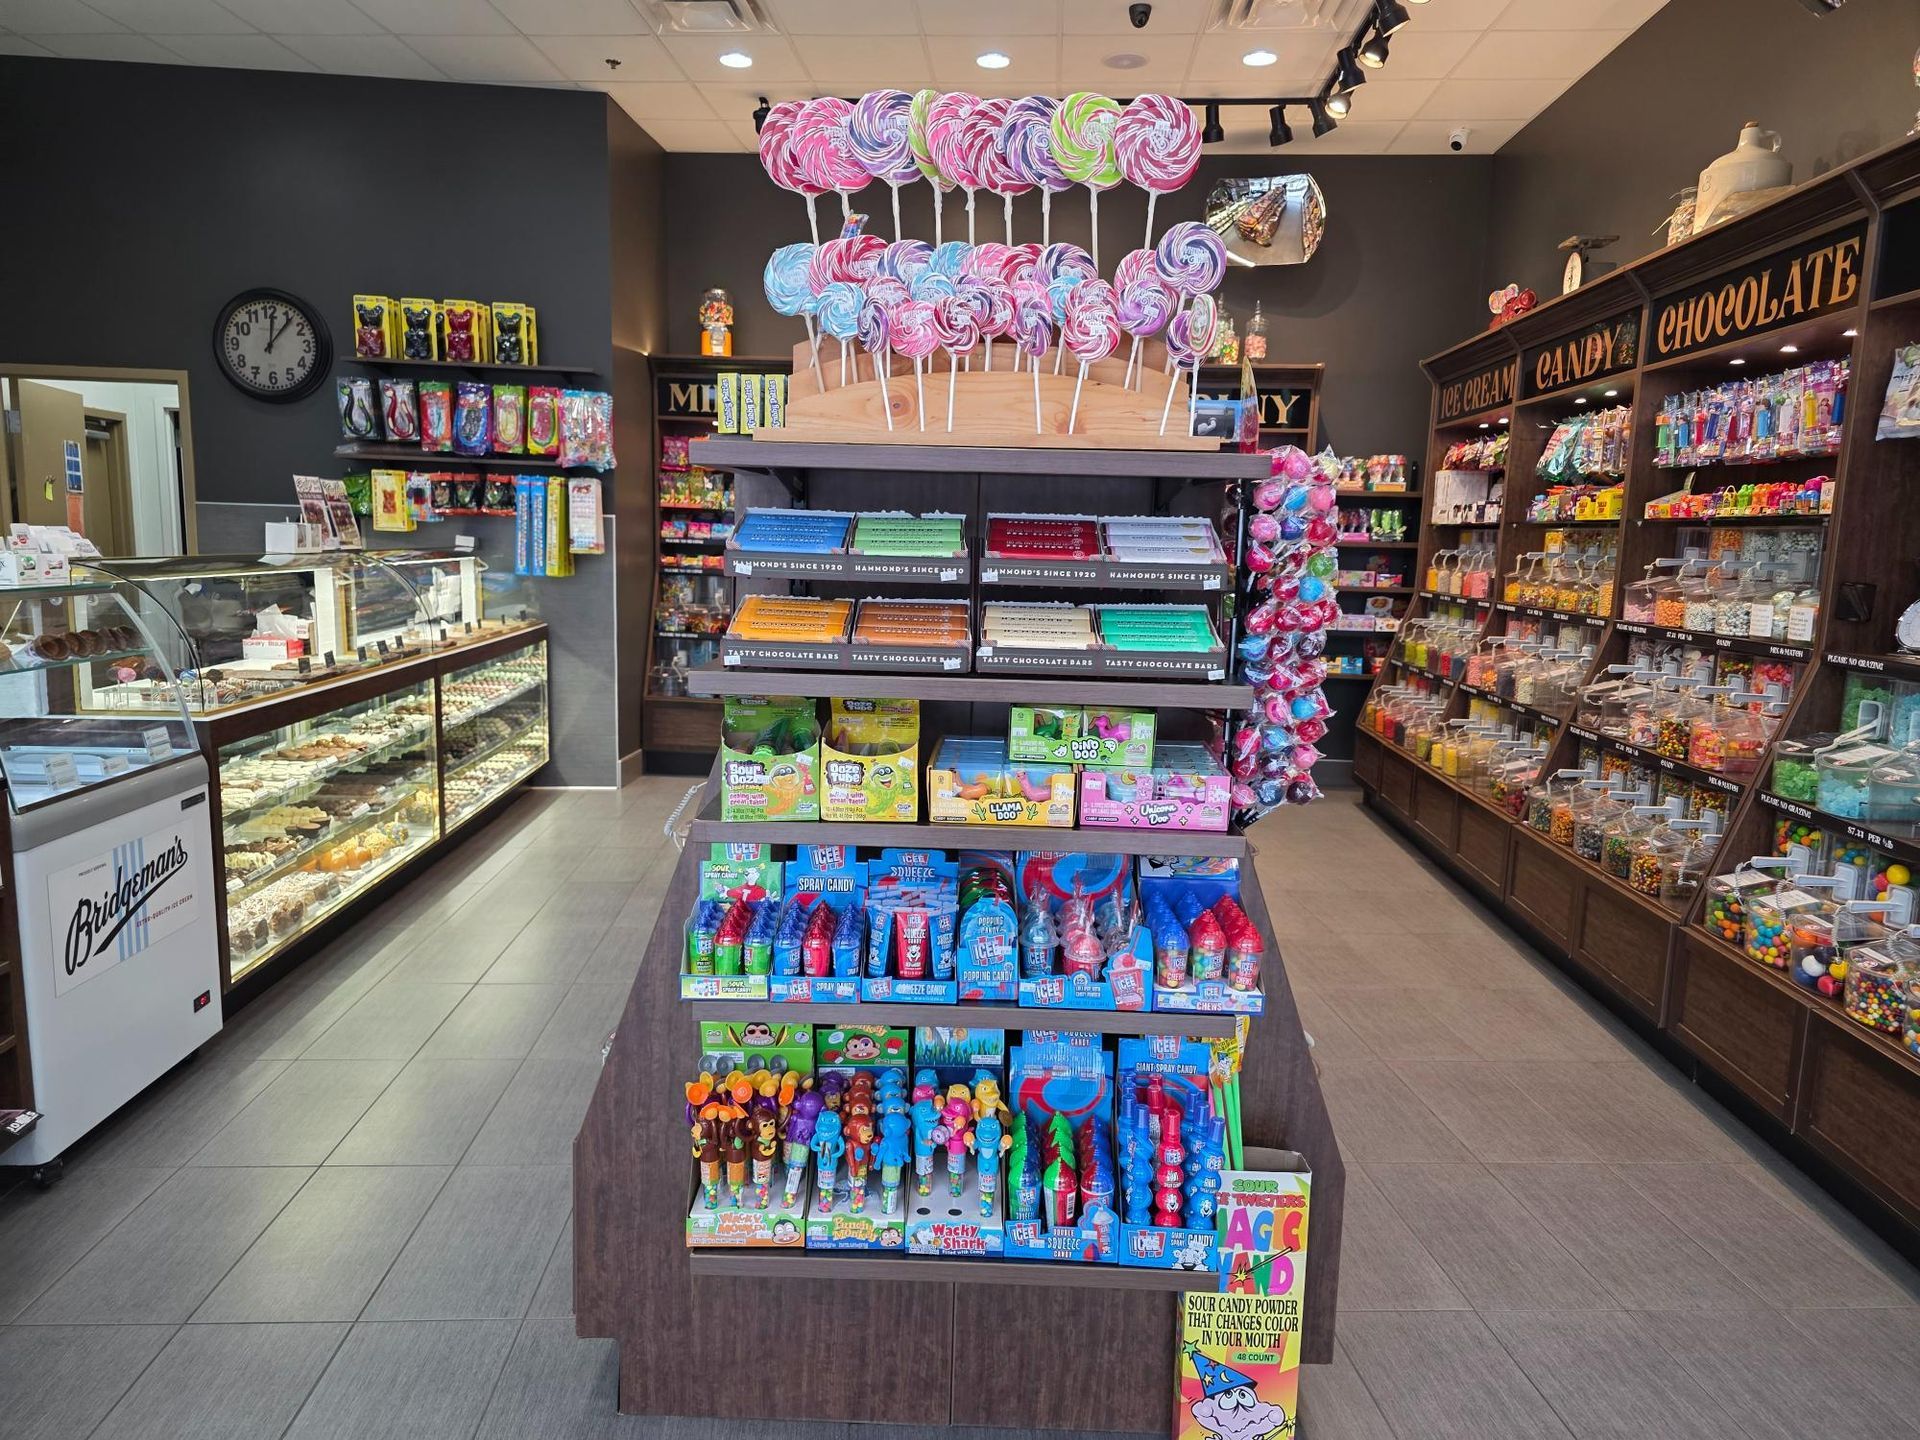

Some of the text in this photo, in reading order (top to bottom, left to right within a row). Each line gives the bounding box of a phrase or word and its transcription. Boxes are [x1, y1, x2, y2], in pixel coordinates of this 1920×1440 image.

[1657, 236, 1861, 354] CHOCOLATE
[246, 309, 258, 323] 11
[261, 305, 278, 320] 12
[233, 321, 250, 336] 10
[296, 322, 306, 336] 2
[230, 337, 240, 350] 9
[302, 340, 312, 354] 3
[238, 354, 246, 368] 8
[298, 356, 306, 370] 4
[1535, 324, 1622, 390] CANDY
[251, 366, 260, 380] 7
[268, 372, 278, 385] 6
[286, 368, 295, 381] 5
[1441, 363, 1516, 419] ICE CREAM
[668, 383, 717, 413] MI
[790, 562, 818, 570] SINCE
[855, 564, 909, 573] HAMMOND'S
[1110, 571, 1165, 580] HAMMOND'S
[1199, 573, 1222, 581] 1920
[728, 649, 756, 658] TASTY
[758, 650, 814, 660] CHOCOLATE
[852, 654, 880, 662] TASTY
[882, 655, 938, 663] CHOCOLATE
[982, 656, 1010, 664] TASTY
[1012, 657, 1068, 666] CHOCOLATE
[1106, 660, 1218, 670] TASTY CHOCOLATE BARS
[1828, 654, 1884, 670] PLEASE NO GRAZING
[1074, 750, 1097, 760] DOO
[730, 764, 761, 775] Sour
[830, 762, 860, 774] Ooze
[830, 773, 860, 782] Tube
[990, 803, 1022, 812] LLAMA
[1140, 804, 1177, 814] Unicorn
[1760, 794, 1812, 819] PLEASE NO GRAZING
[998, 812, 1016, 820] DOO
[1150, 814, 1169, 824] Doo
[1868, 833, 1881, 845] PER
[814, 846, 842, 866] ICEE
[902, 855, 925, 863] ICEE
[712, 864, 730, 872] SOUR
[890, 866, 936, 878] SQUEEZE
[798, 878, 855, 892] SPRAY CANDY
[65, 835, 188, 976] Bridgeman's
[978, 916, 1004, 926] POPPING
[903, 928, 926, 939] SQUEEZE
[973, 941, 1001, 960] ICEE
[964, 971, 1012, 980] POPPING CANDY
[1236, 976, 1252, 985] CHEWS
[790, 982, 809, 996] ICEE
[816, 982, 834, 992] SPRAY
[870, 984, 890, 994] ICEE
[1120, 976, 1136, 990] ICEE
[926, 984, 946, 996] CANDY
[1036, 982, 1060, 998] ICEE
[1196, 1002, 1222, 1011] CHEWS
[1070, 1038, 1090, 1047] CANDY
[1153, 1039, 1176, 1054] ICEE
[1136, 1062, 1198, 1075] GIANT SPRAY CANDY
[1232, 1179, 1279, 1194] SOUR
[1232, 1193, 1307, 1208] TWISTERS
[931, 1224, 978, 1238] Wacky
[1012, 1227, 1035, 1241] ICEE
[1053, 1228, 1074, 1236] DOUBLE
[943, 1237, 986, 1250] Shark
[1048, 1237, 1080, 1250] SQUEEZE
[1188, 1234, 1214, 1247] CANDY
[1053, 1250, 1072, 1258] CANDY
[1188, 1296, 1298, 1316] SOUR CANDY POWDER
[1188, 1312, 1299, 1332] THAT CHANGES COLOR
[1202, 1330, 1281, 1349] IN YOUR MOUTH
[1236, 1353, 1275, 1362] 48 COUNT
